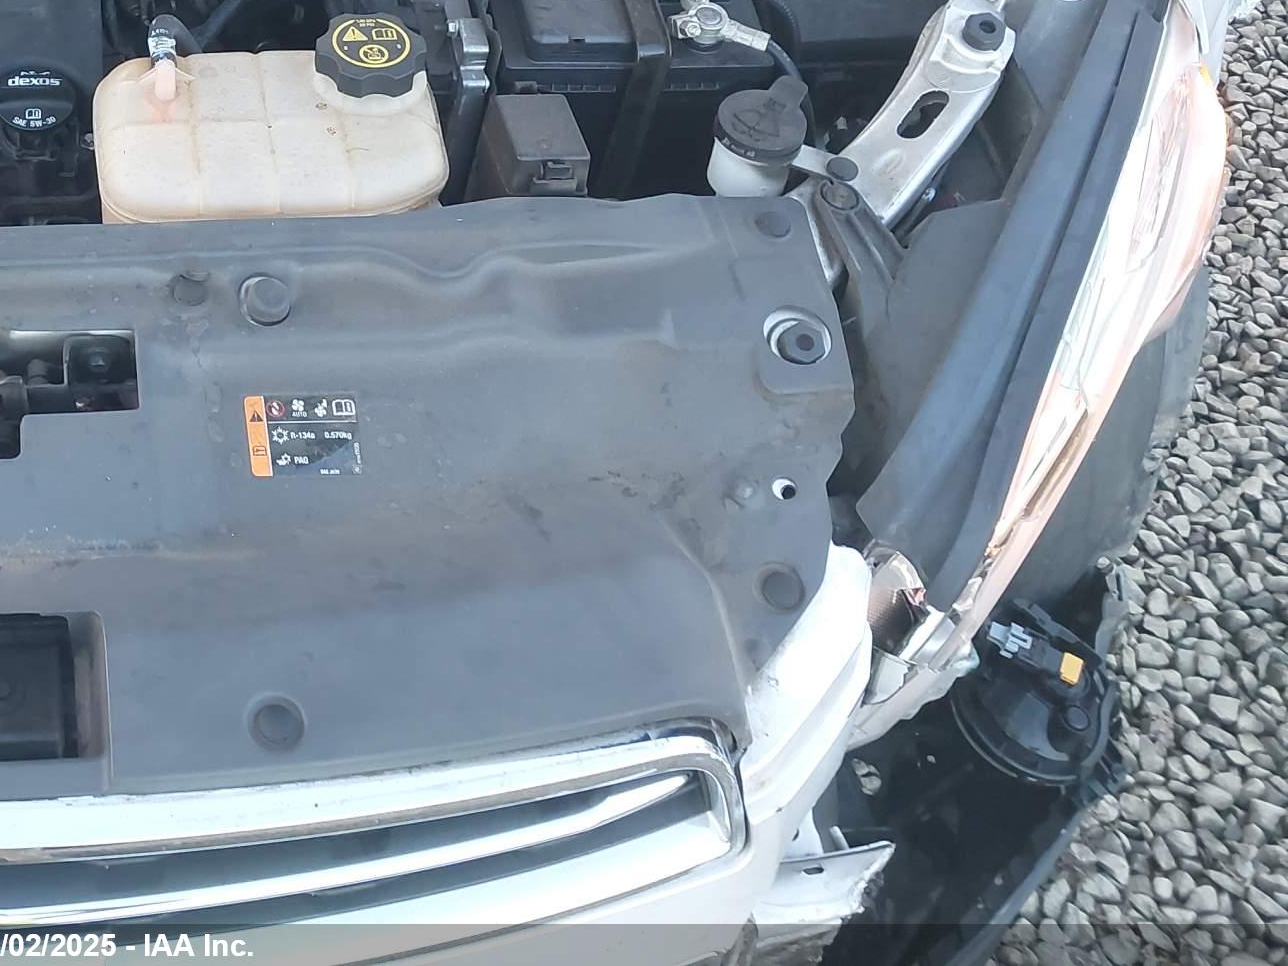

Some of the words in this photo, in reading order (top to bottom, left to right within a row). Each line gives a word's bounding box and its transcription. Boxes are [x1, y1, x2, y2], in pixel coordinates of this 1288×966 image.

[7, 75, 62, 87] dexos
[12, 116, 27, 128] SAE
[29, 115, 57, 128] 5W-30
[290, 431, 316, 440] R-134a
